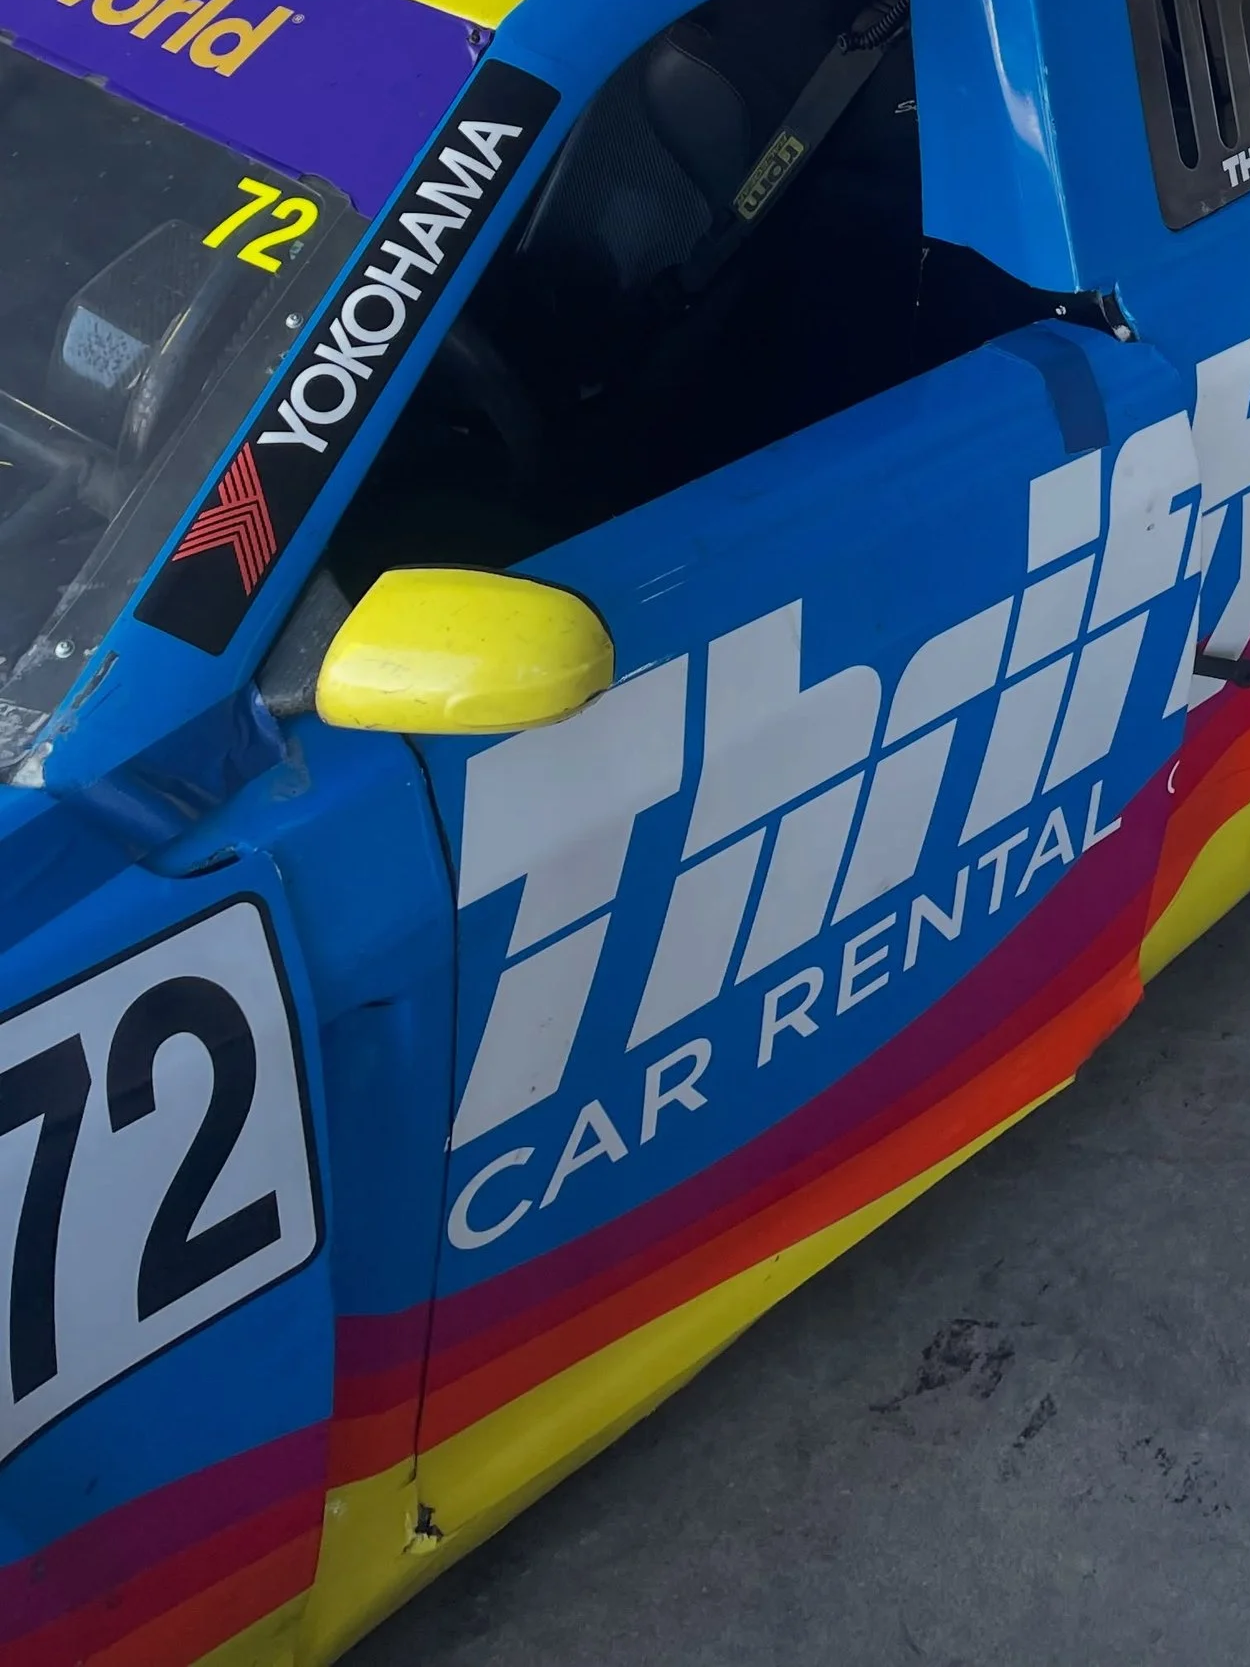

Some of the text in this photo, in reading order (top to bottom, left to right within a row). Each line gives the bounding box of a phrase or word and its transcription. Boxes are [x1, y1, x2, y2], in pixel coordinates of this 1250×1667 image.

[202, 177, 319, 273] 72
[257, 120, 523, 453] YOKOHAMA
[744, 145, 799, 212] rpm
[447, 783, 1122, 1250] CAR RENTAL
[0, 975, 282, 1404] 72
